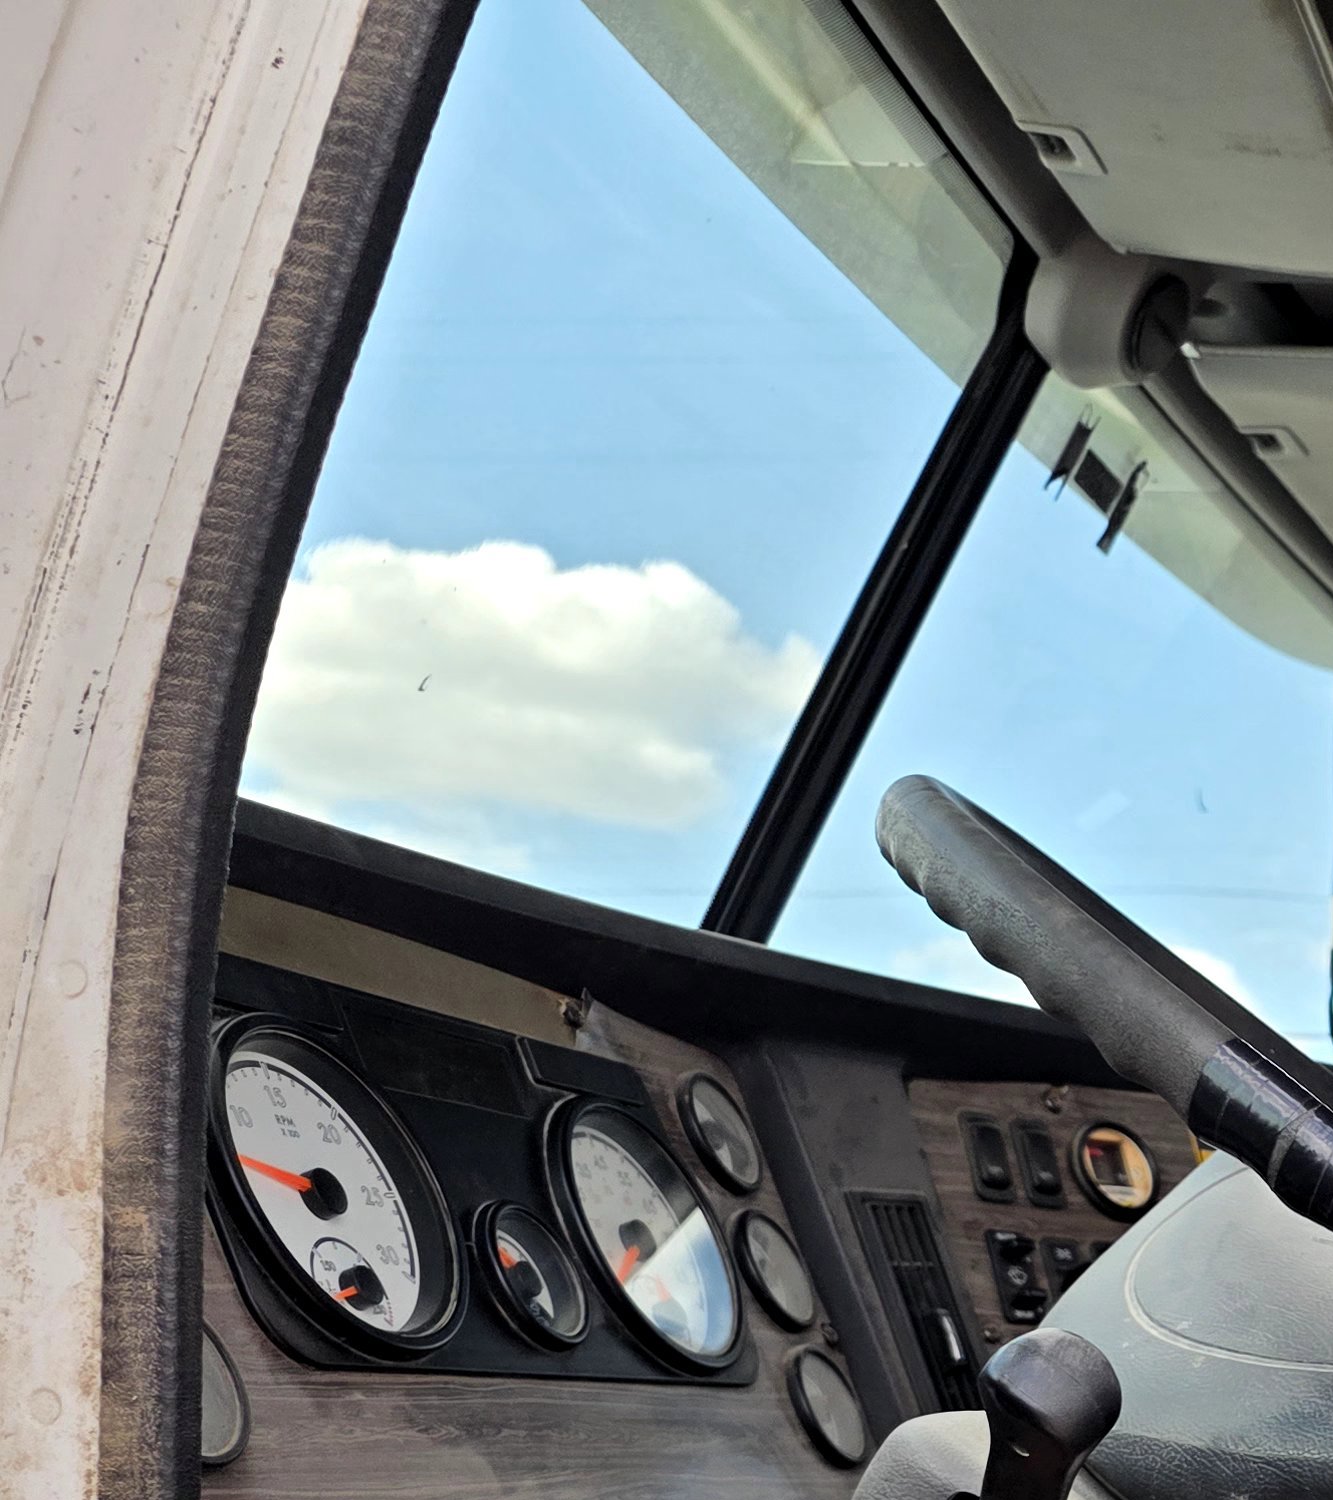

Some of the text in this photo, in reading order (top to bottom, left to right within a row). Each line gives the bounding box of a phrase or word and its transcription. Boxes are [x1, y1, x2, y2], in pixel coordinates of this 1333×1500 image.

[263, 1085, 287, 1109] 15
[229, 1104, 254, 1129] 10
[274, 1113, 297, 1127] RPM
[316, 1121, 342, 1145] 20
[360, 1185, 385, 1208] 25
[375, 1243, 400, 1266] 30
